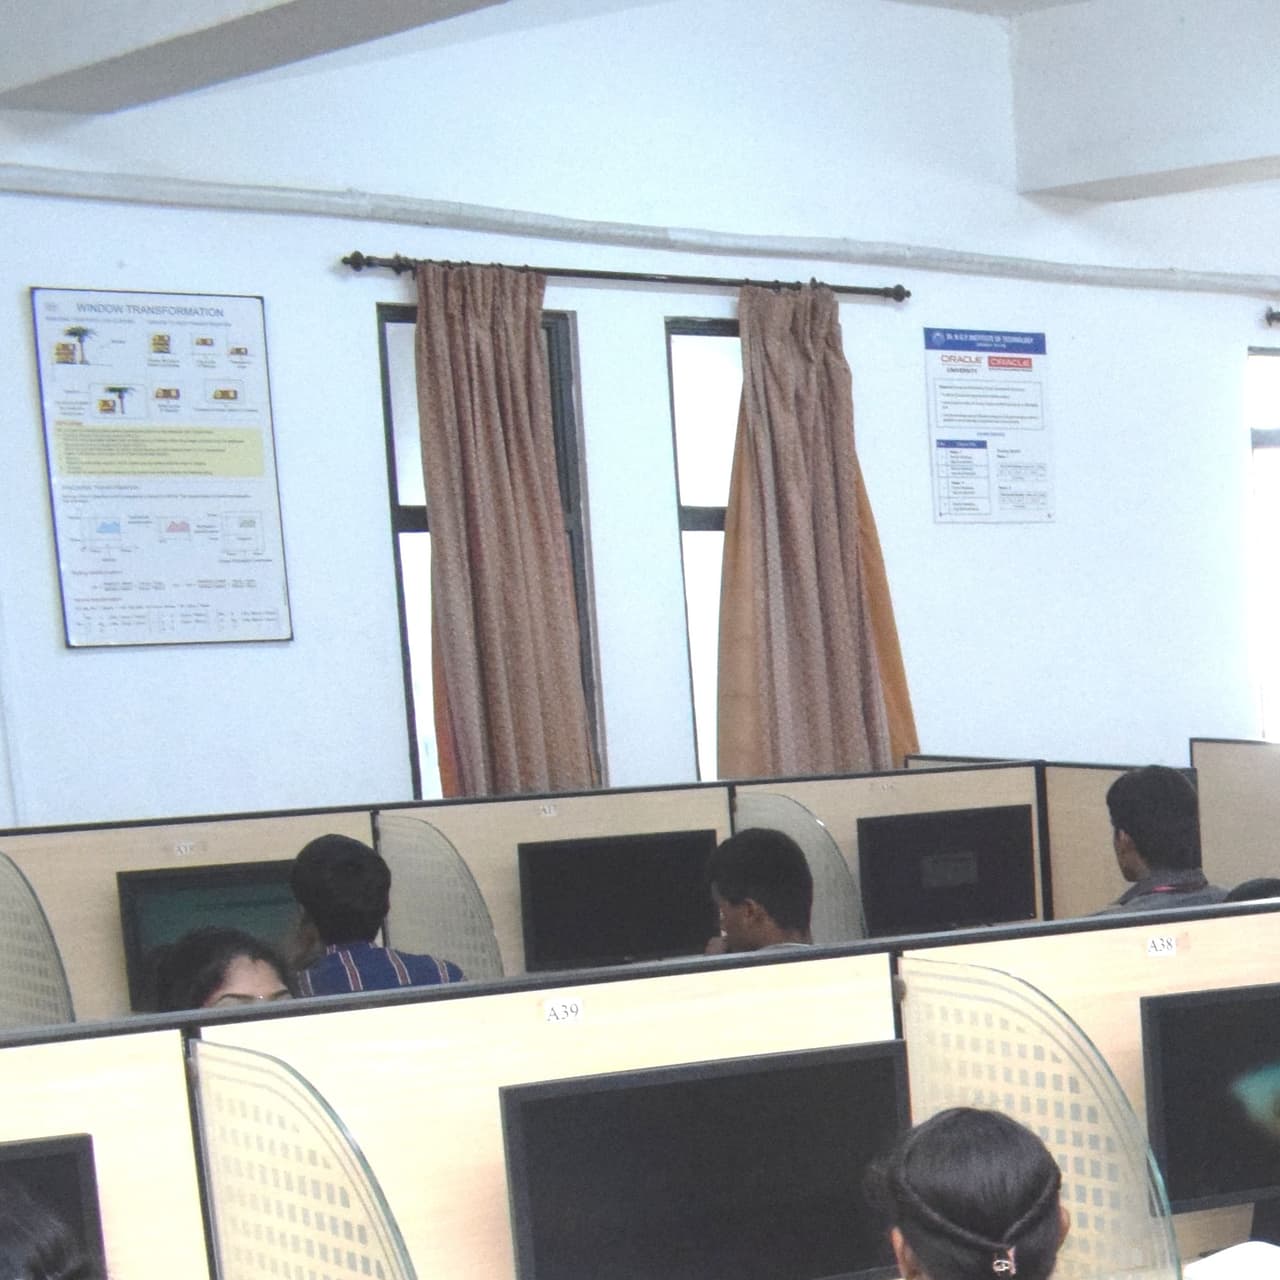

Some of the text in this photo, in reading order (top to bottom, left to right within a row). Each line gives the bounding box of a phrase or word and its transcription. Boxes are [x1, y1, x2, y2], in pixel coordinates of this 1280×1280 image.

[77, 303, 224, 318] WINDOW TRANSFORMATION
[941, 354, 982, 364] ORACLE
[1148, 937, 1174, 952] A38
[547, 1003, 579, 1021] A39
